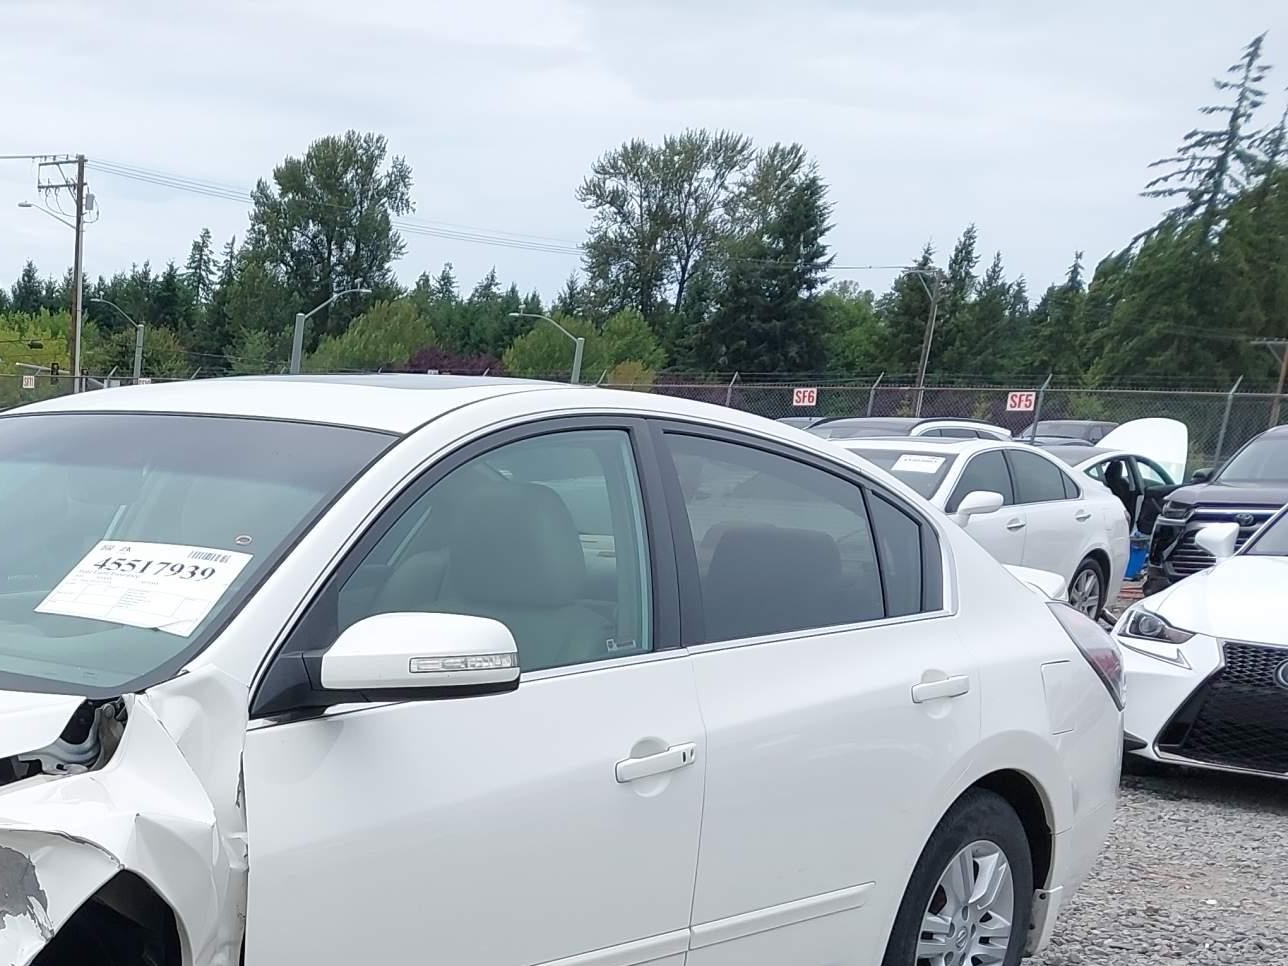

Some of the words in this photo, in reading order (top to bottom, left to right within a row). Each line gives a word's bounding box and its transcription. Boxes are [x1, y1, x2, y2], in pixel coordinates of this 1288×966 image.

[795, 390, 815, 404] SF6
[1009, 393, 1033, 409] SF5
[93, 556, 216, 582] 45517939
